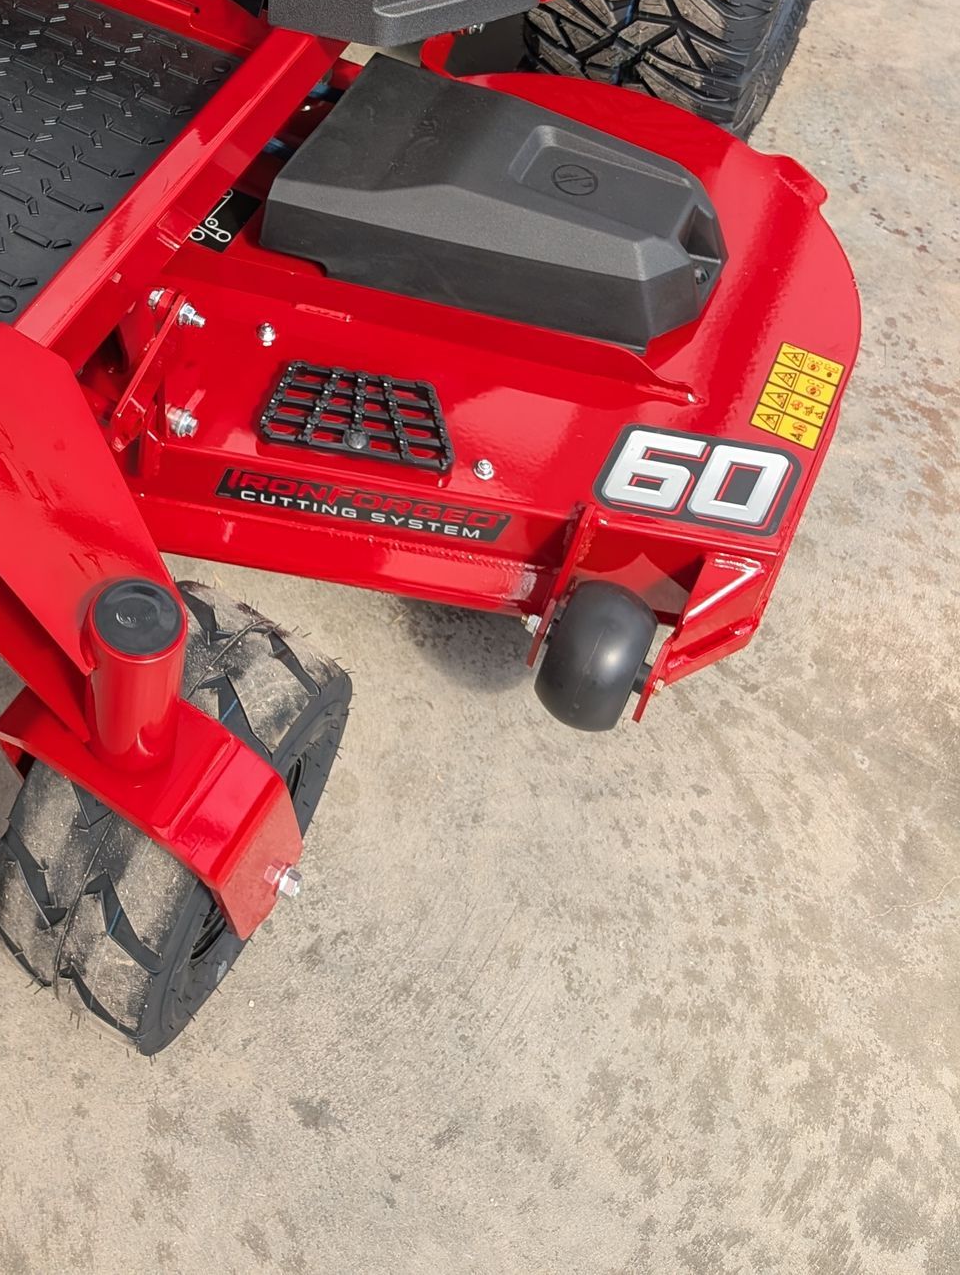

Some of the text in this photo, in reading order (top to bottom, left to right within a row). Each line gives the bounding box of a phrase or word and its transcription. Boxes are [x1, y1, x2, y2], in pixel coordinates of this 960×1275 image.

[240, 490, 480, 540] CUTTING SYSTEM
[601, 429, 793, 529] 60
